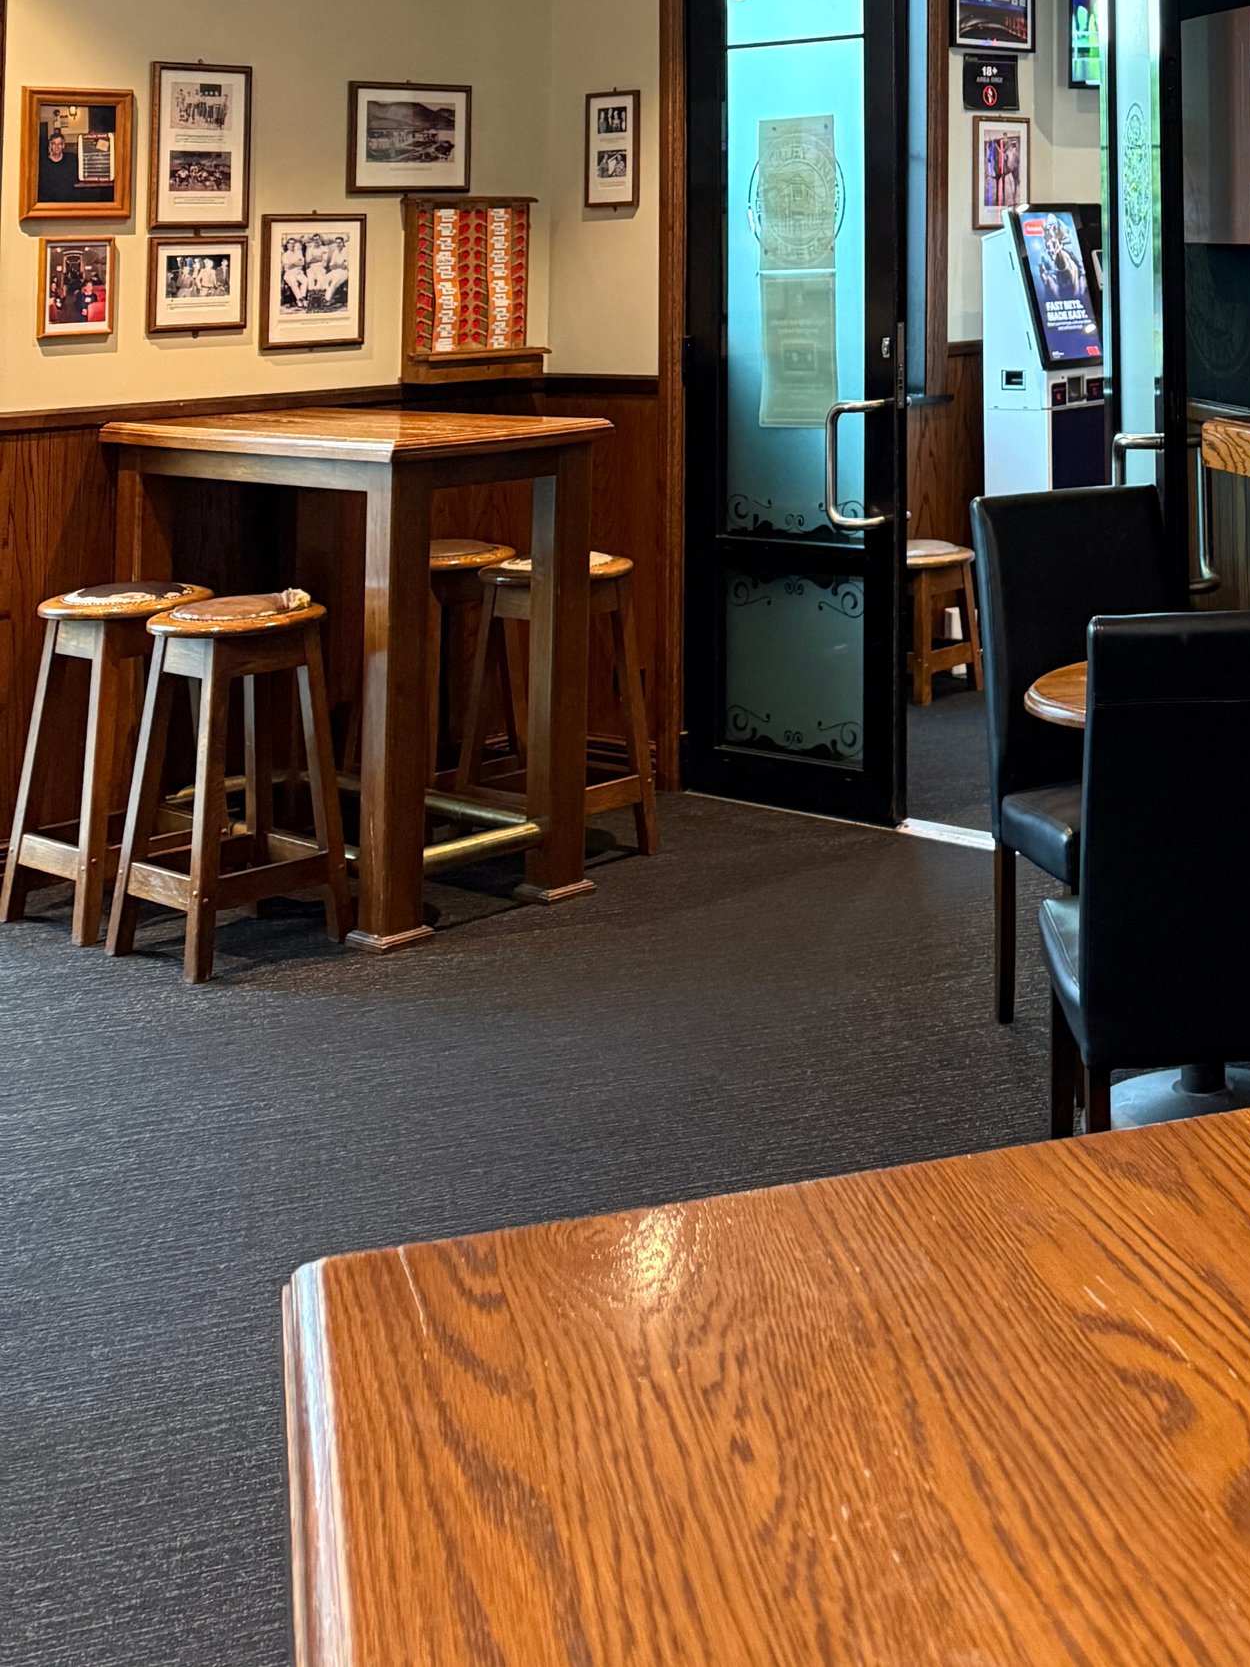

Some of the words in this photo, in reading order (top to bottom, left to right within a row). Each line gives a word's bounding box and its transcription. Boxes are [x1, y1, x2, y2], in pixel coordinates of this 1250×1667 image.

[982, 66, 998, 76] 18+
[1045, 300, 1063, 311] FAST
[1047, 310, 1067, 321] MADE
